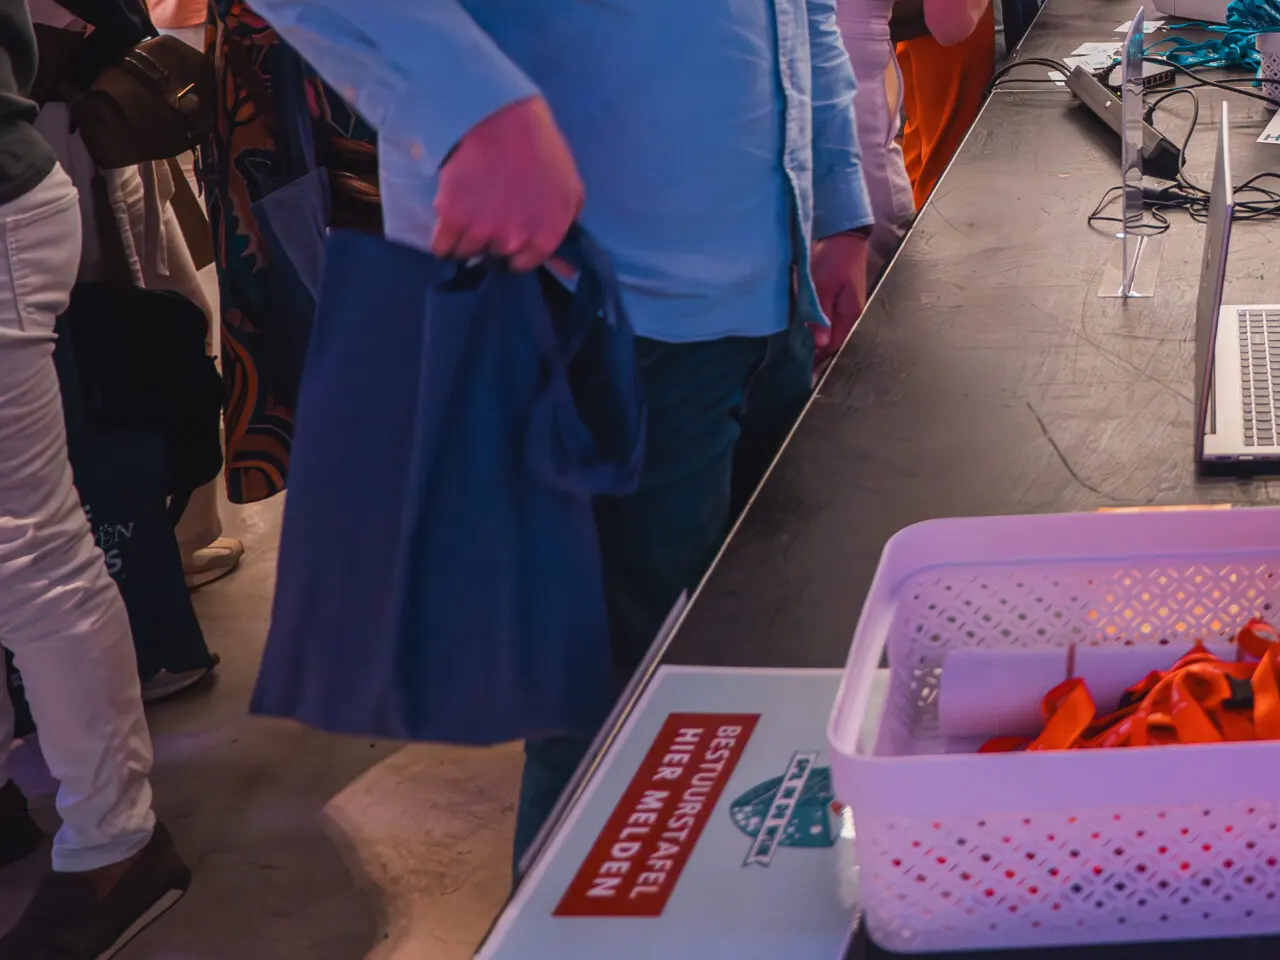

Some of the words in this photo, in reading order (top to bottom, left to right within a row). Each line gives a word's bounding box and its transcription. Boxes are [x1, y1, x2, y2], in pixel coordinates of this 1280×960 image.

[651, 727, 704, 781] HIER
[585, 790, 670, 898] MELDEN
[629, 725, 743, 899] BESTUURSTAFEL
